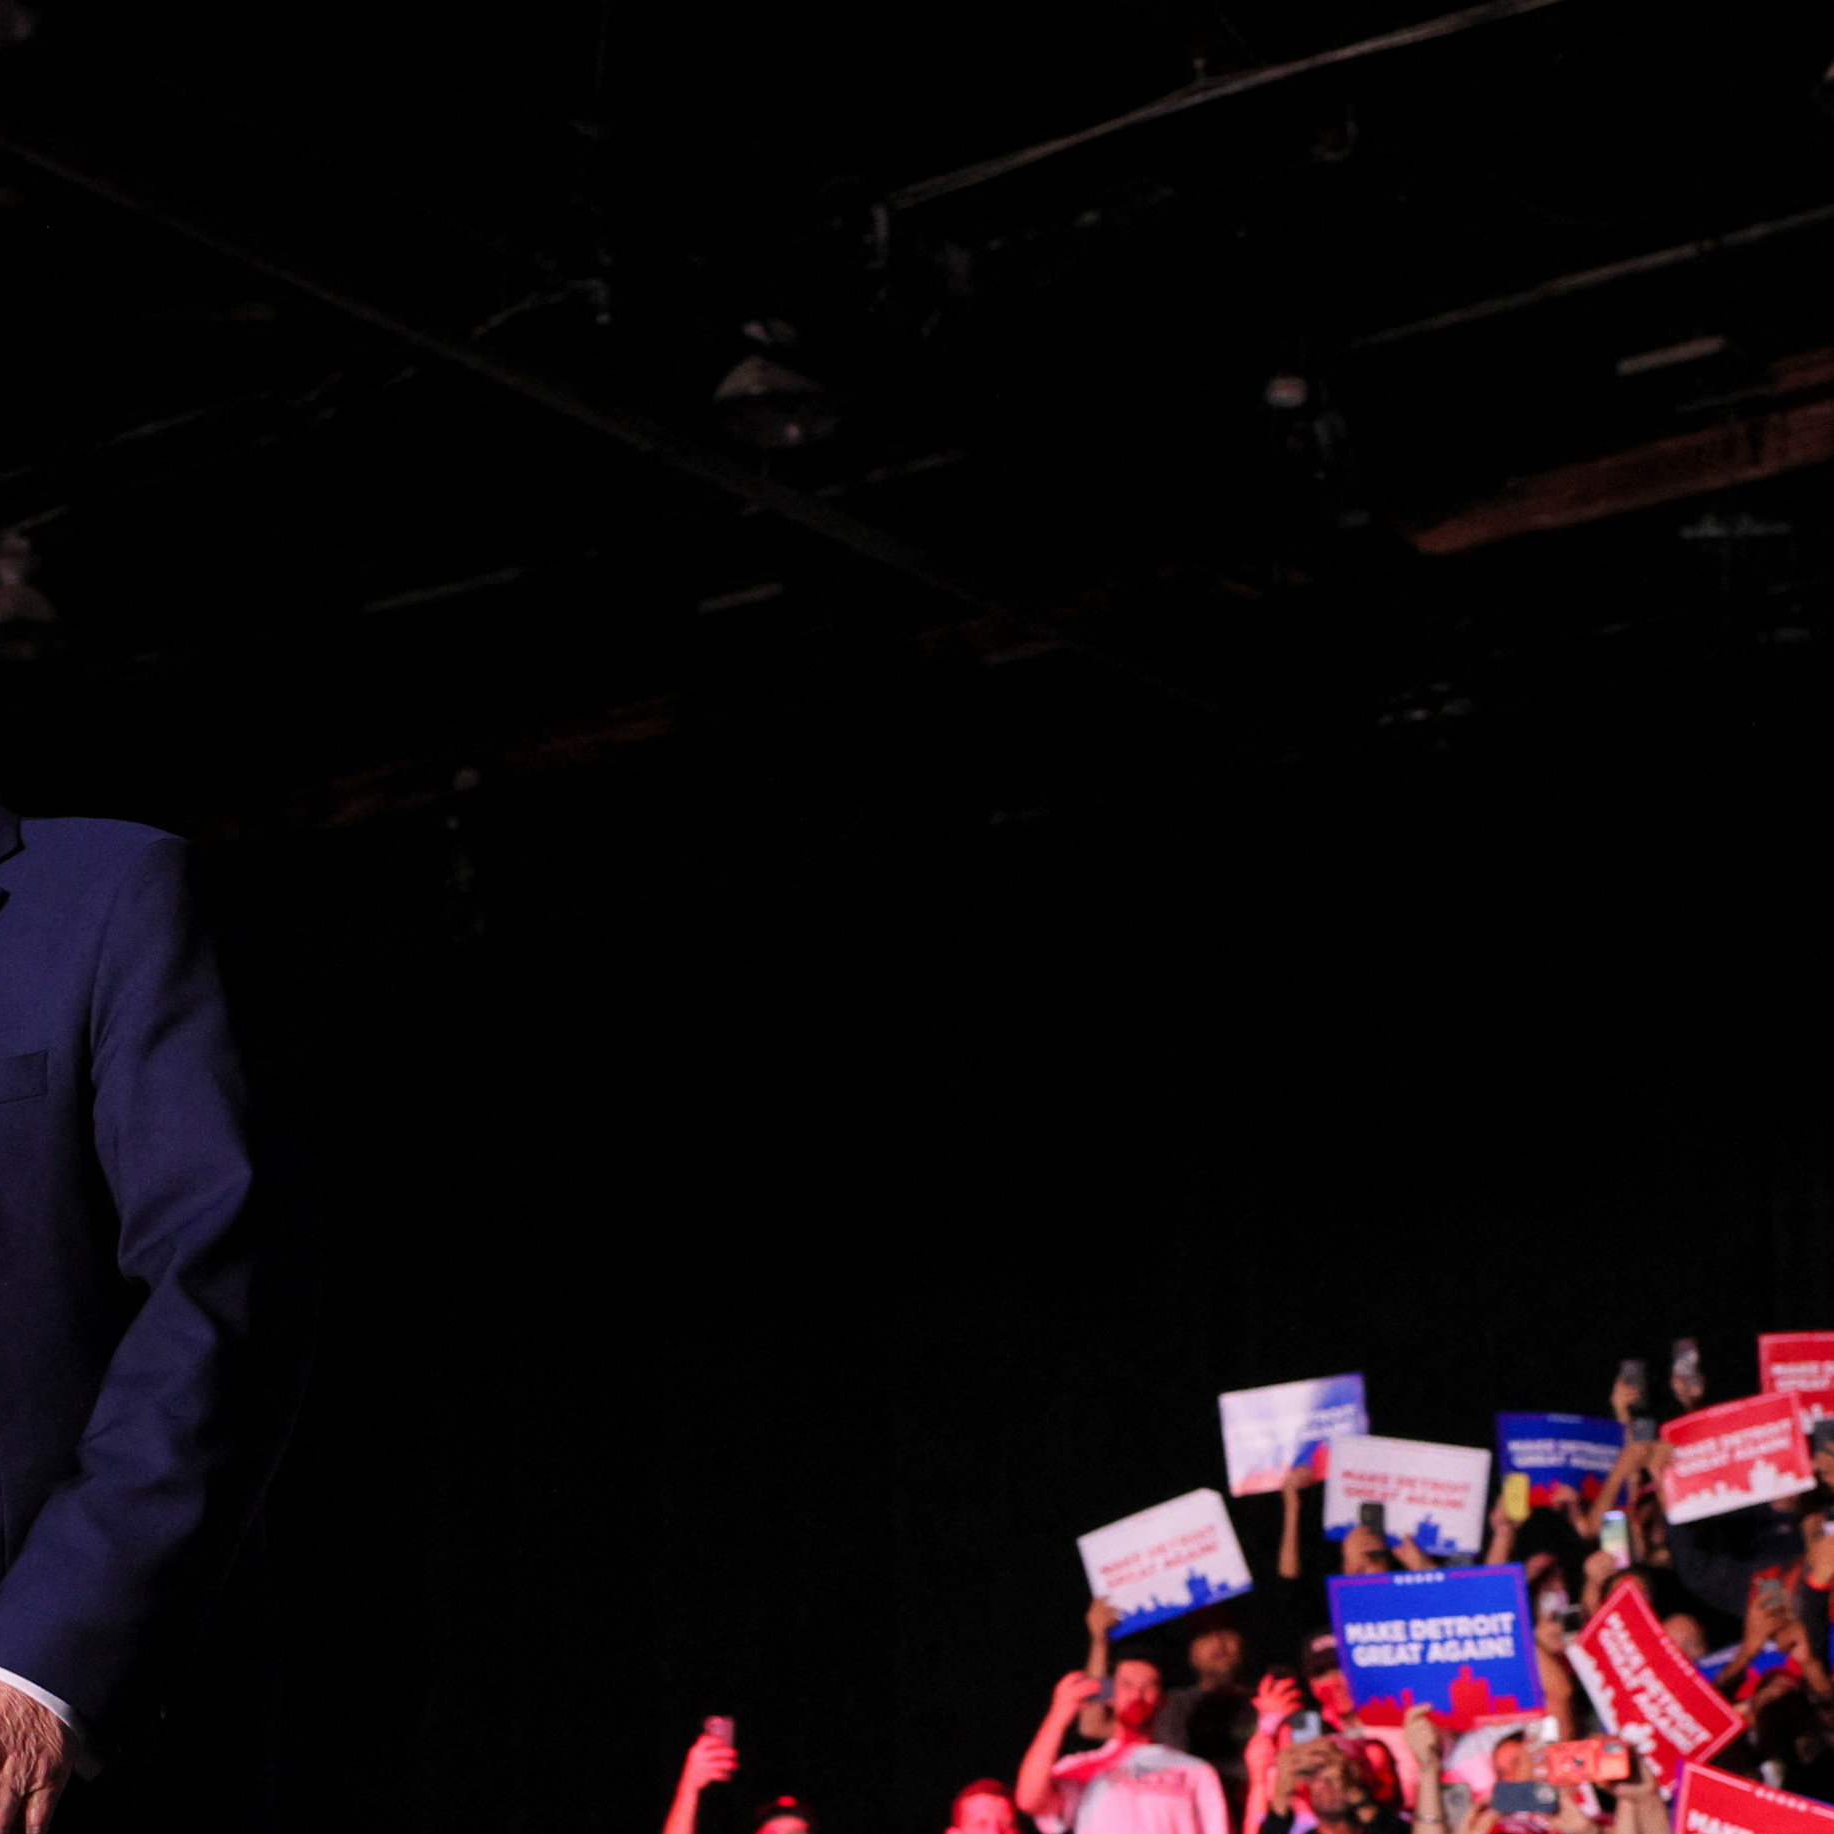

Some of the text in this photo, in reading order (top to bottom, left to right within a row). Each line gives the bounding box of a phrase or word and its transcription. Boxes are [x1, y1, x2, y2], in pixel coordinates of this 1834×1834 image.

[1344, 1611, 1515, 1645] MAKE DETROIT
[1352, 1642, 1424, 1667] GREAT
